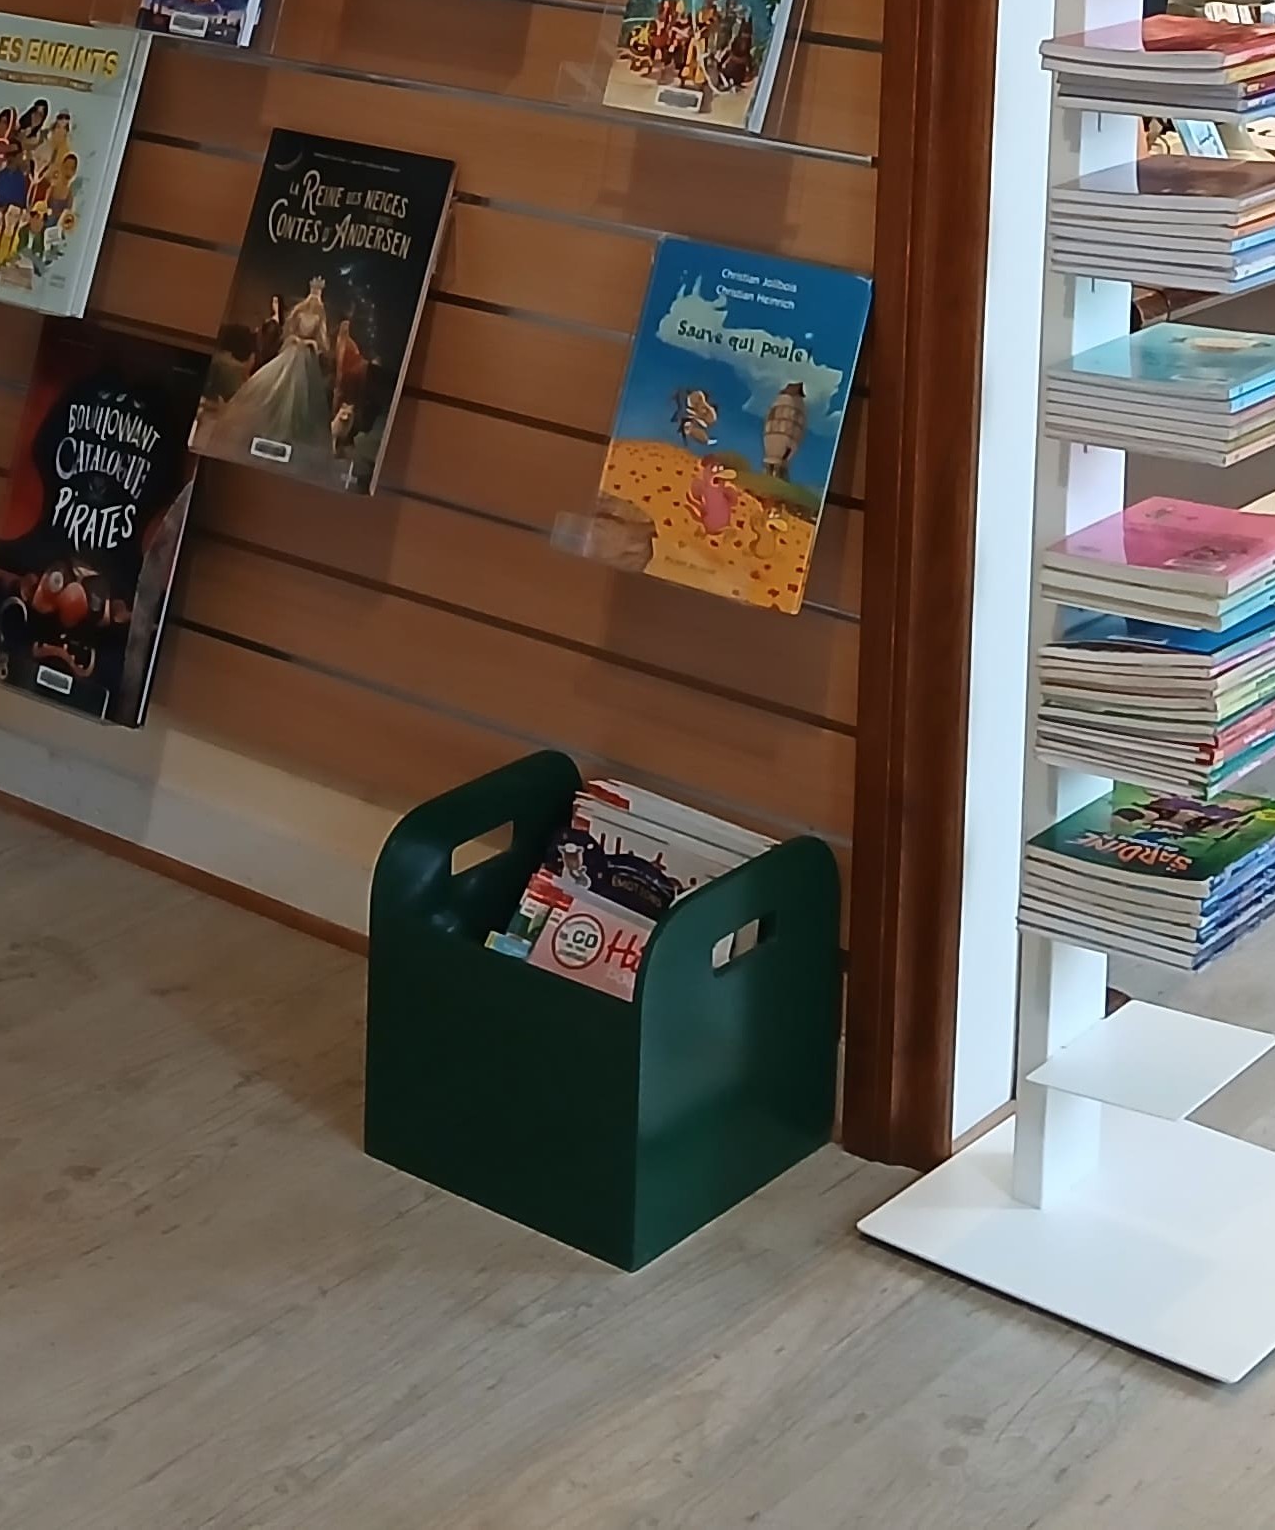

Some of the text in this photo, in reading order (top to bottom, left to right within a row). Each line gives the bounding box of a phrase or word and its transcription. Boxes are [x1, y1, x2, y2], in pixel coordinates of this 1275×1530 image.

[26, 37, 121, 78] ENFANTS
[300, 169, 342, 216] REINE
[363, 188, 409, 218] NEIGES
[268, 198, 322, 244] CONTES
[716, 283, 795, 311] Christian Heinrich
[721, 268, 760, 285] Christian
[677, 319, 723, 345] Sauve
[728, 333, 755, 354] qui
[759, 337, 803, 363] poule
[55, 436, 151, 499] CATALOGUE
[51, 486, 137, 551] PIRATES
[1065, 832, 1192, 872] SARDINE
[572, 929, 598, 949] CD
